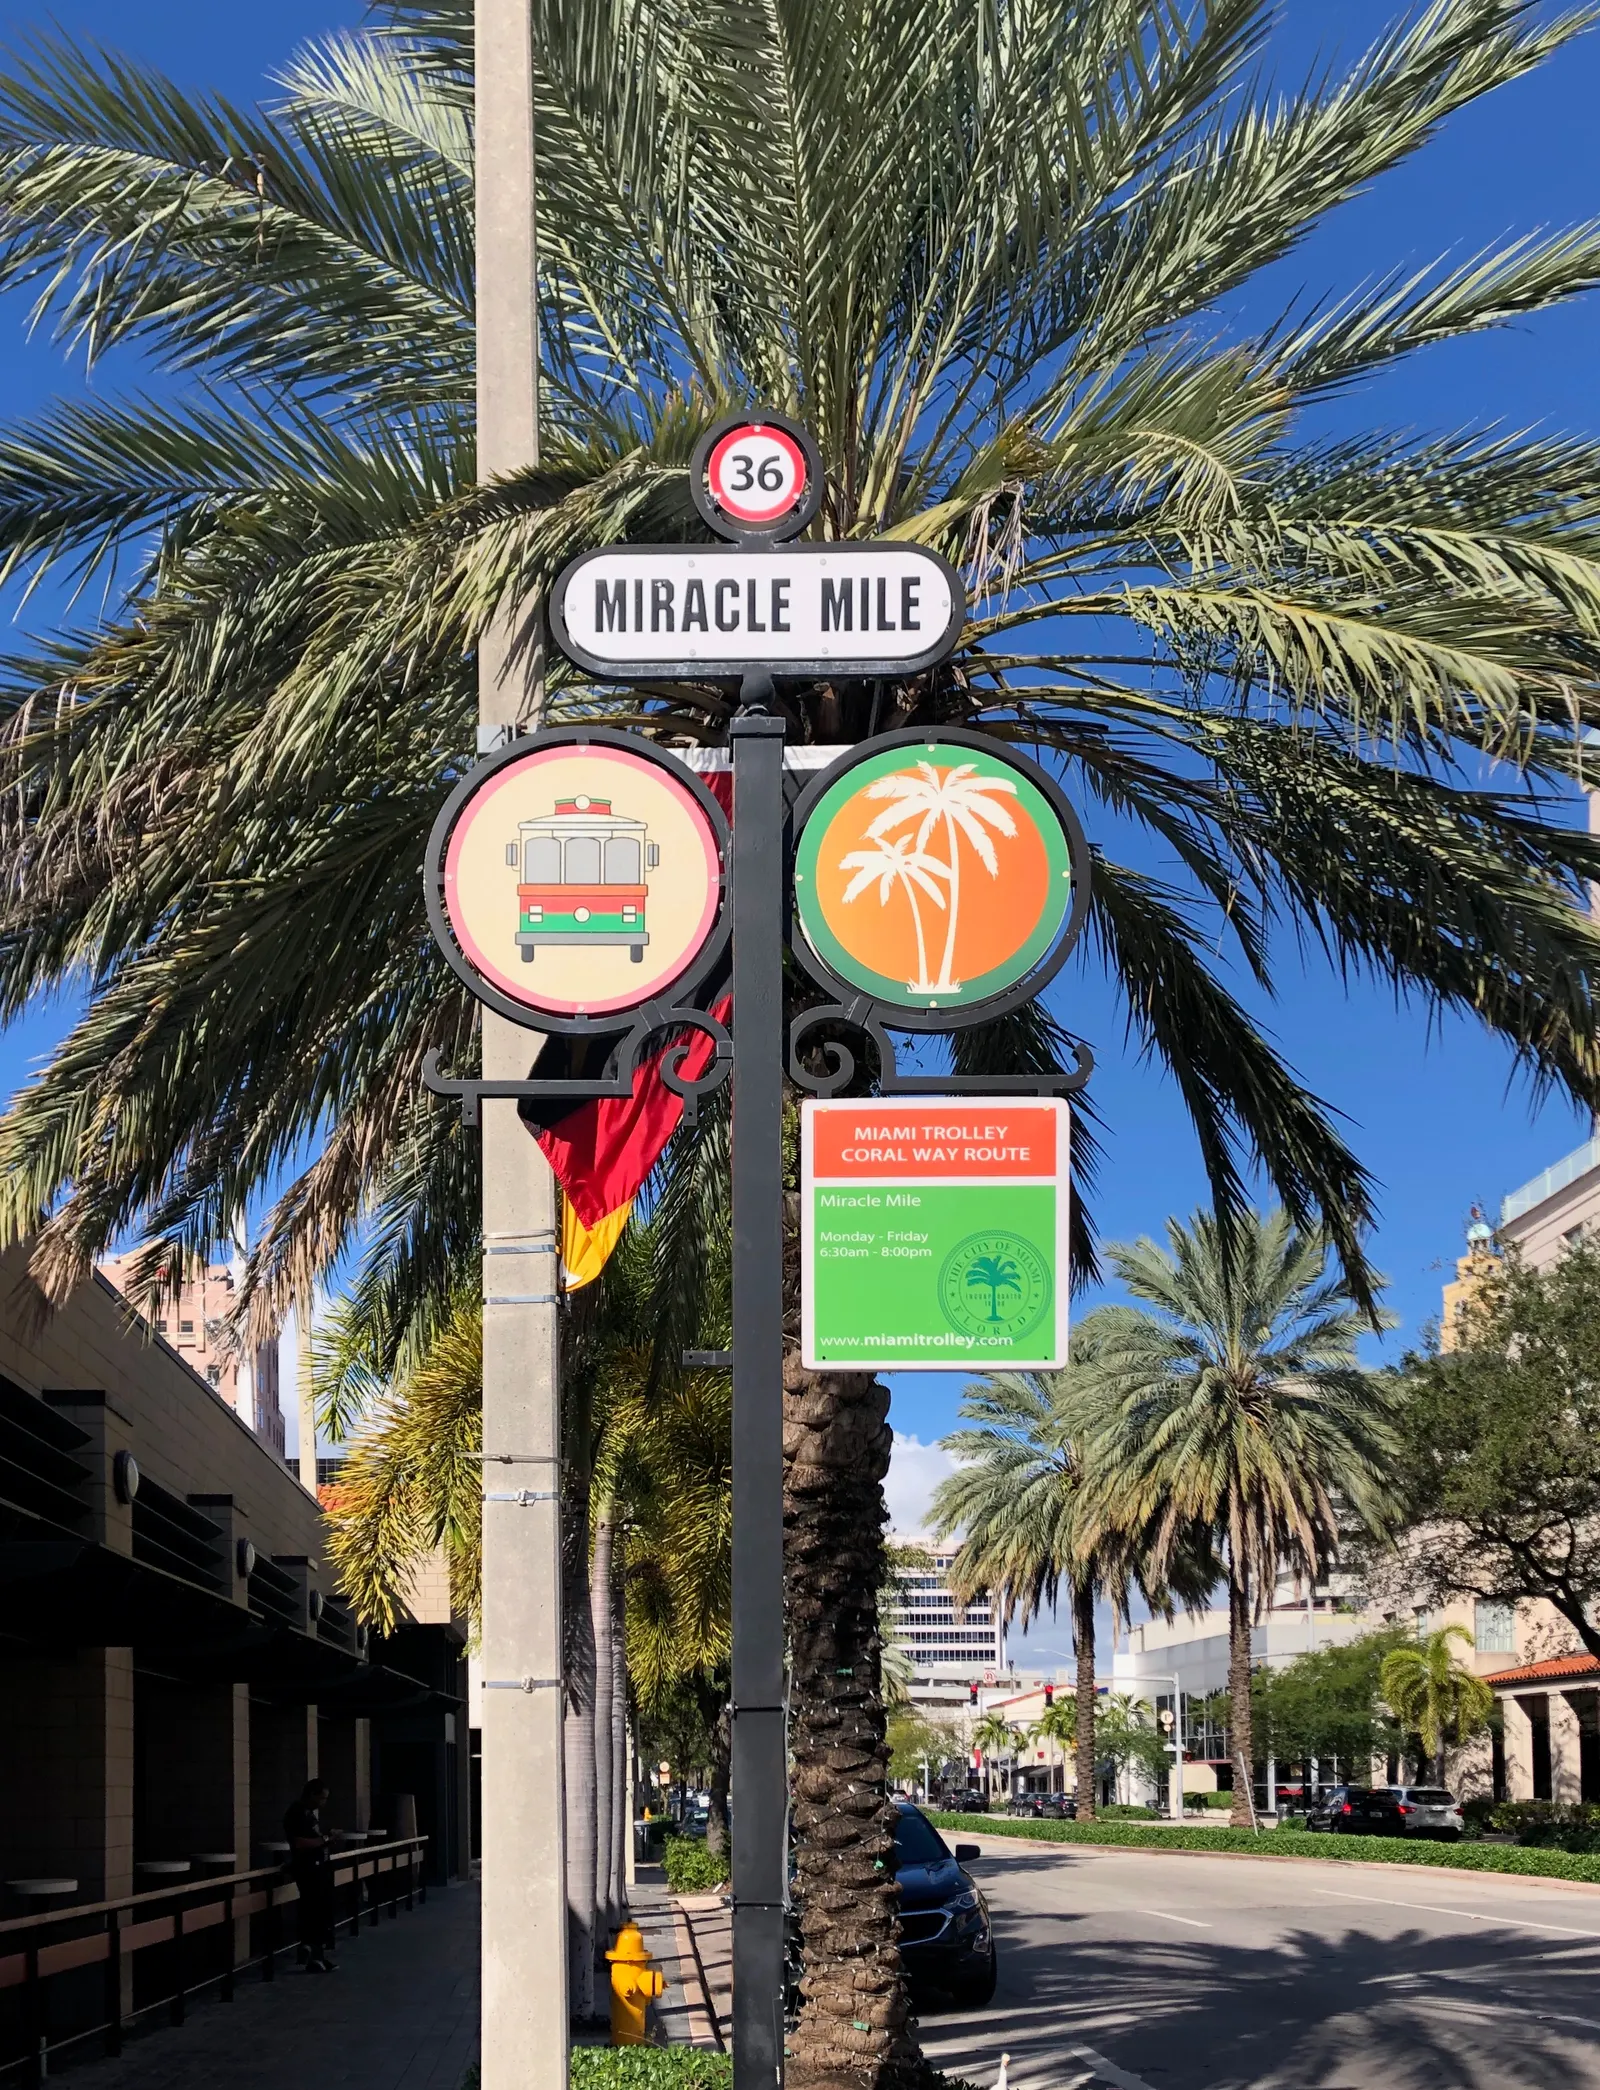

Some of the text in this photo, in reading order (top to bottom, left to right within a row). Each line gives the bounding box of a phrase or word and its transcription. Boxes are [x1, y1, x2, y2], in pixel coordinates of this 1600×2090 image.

[730, 455, 784, 491] 36
[595, 576, 921, 633] MIRACLE MILE
[854, 1126, 1008, 1141] MIAMI TROLLEY
[841, 1147, 1030, 1162] CORAL WAY ROUTE
[820, 1194, 921, 1207] Miracle Mile
[820, 1231, 875, 1244] Monday
[887, 1231, 929, 1244] Friday
[819, 1247, 869, 1257] 6:30am
[880, 1247, 932, 1259] 8:00pm
[948, 1241, 1041, 1284] THE CITY OF MIAMI
[953, 1304, 1037, 1336] FLORIDA
[820, 1332, 1014, 1349] www.miamitrolley.com
